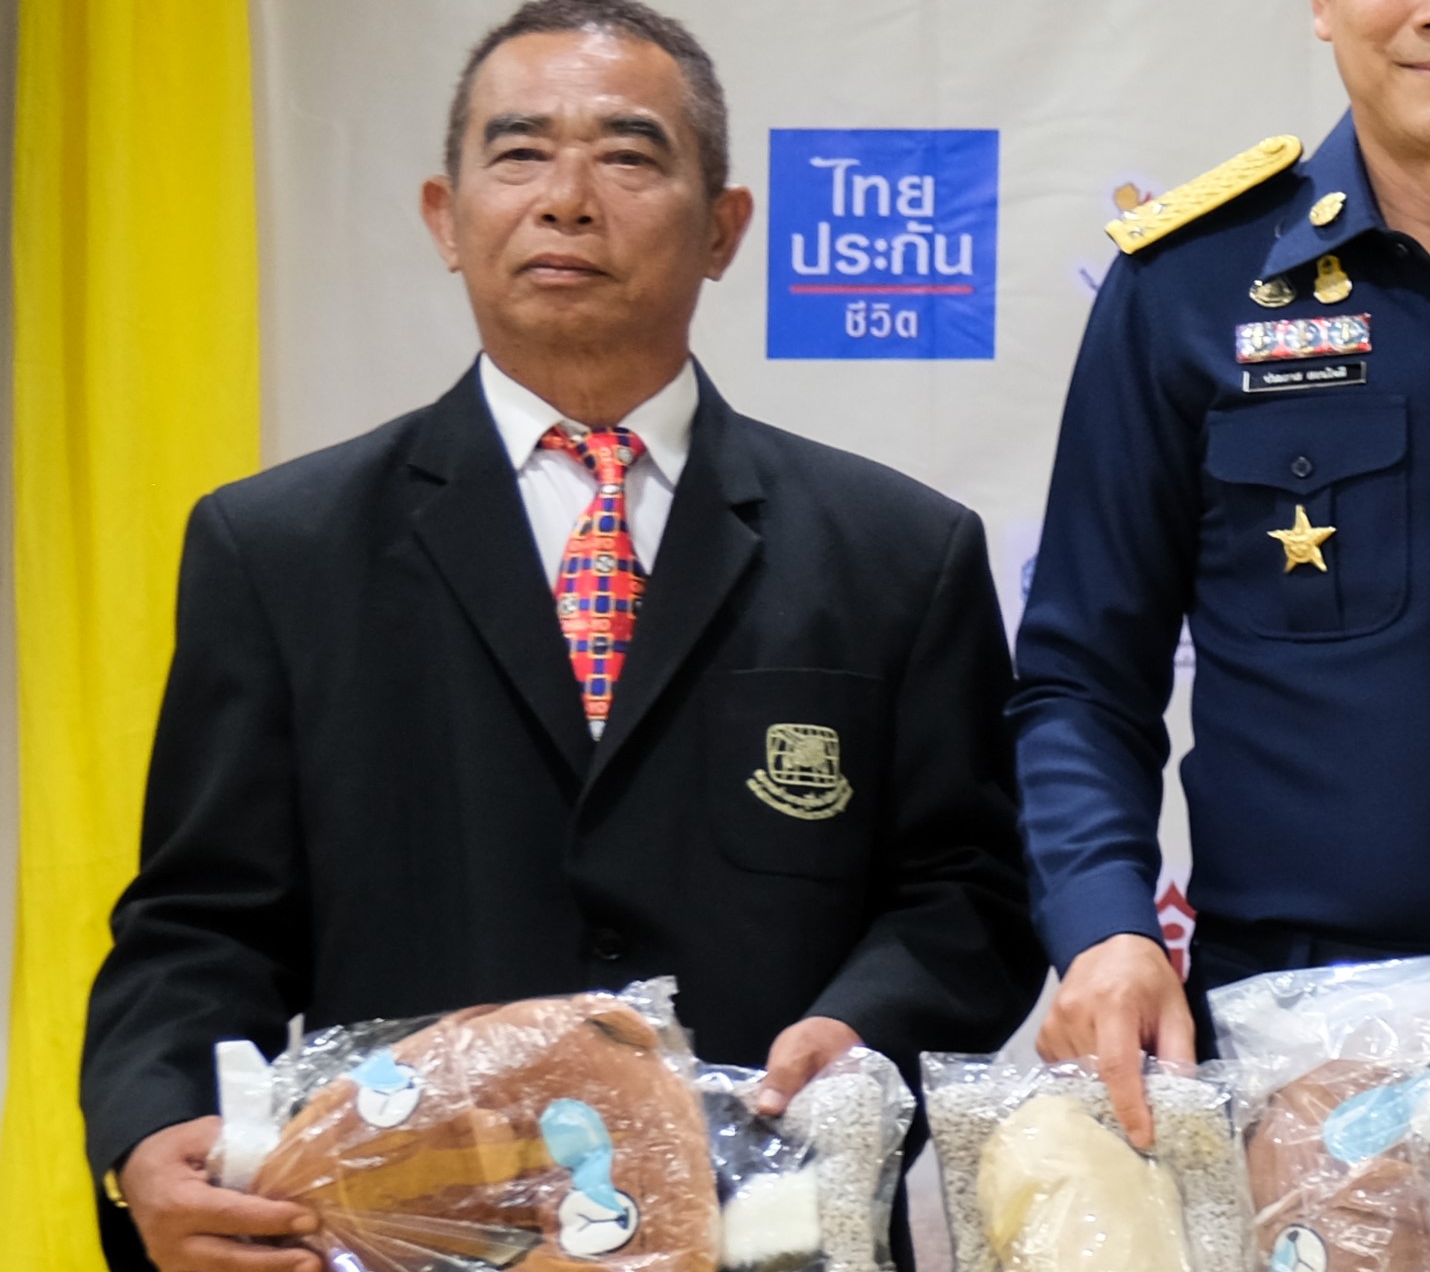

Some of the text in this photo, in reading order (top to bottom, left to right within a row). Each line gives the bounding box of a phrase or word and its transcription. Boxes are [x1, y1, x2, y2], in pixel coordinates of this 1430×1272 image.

[810, 157, 935, 218] ไทย
[790, 222, 973, 276] ประกัน
[845, 302, 918, 338] ชีวิต
